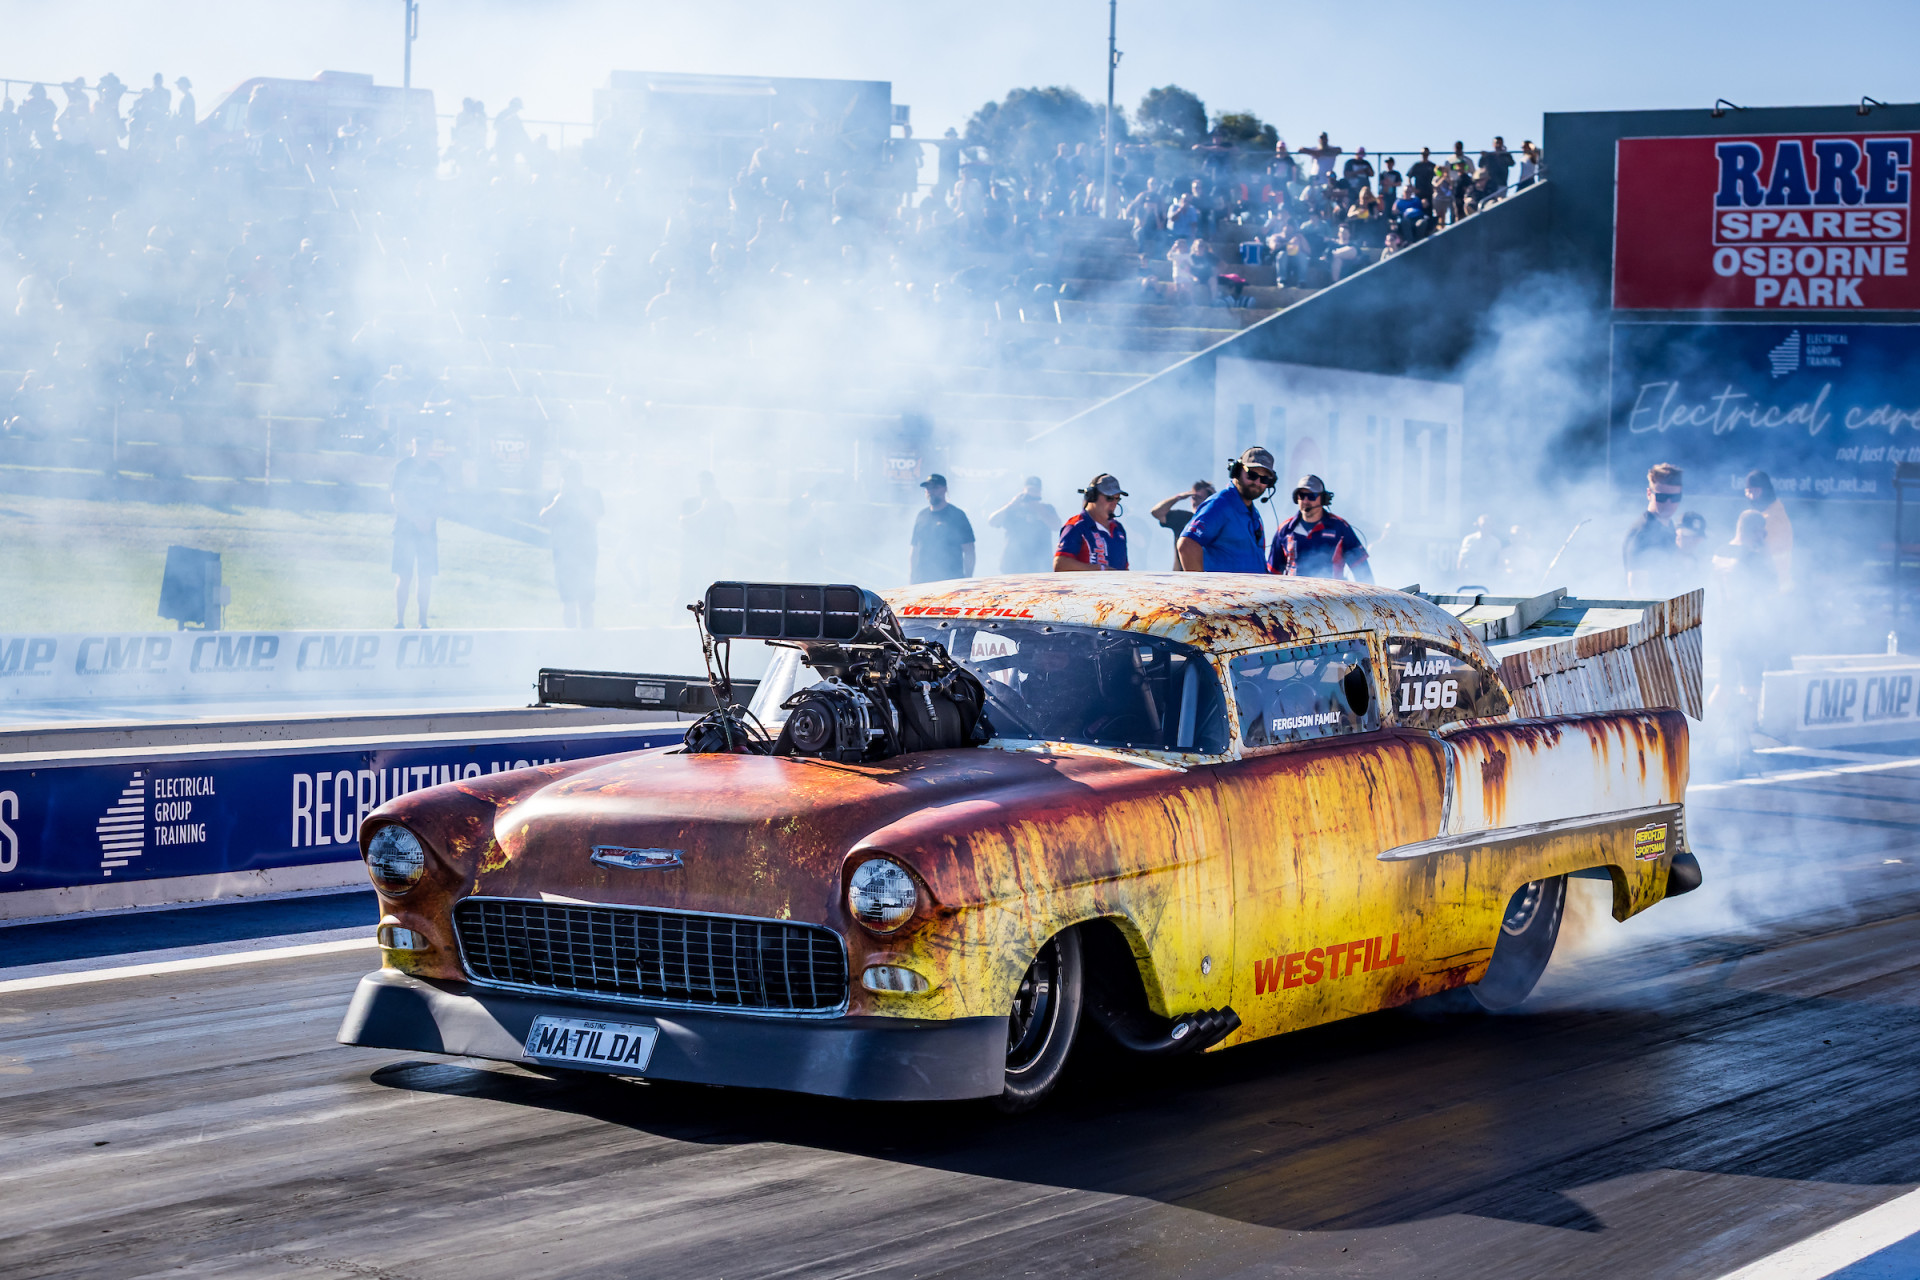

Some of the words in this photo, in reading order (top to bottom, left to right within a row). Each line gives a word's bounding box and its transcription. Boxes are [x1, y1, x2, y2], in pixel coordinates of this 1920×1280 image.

[1714, 138, 1912, 207] RARE
[1720, 211, 1903, 240] SPARES
[1713, 247, 1908, 277] OSBORNE
[1755, 278, 1864, 306] PARK
[1806, 334, 1848, 345] ELECTRICAL
[1806, 356, 1841, 367] TRAINING
[1629, 381, 1831, 436] Electrical
[1908, 446, 1920, 462] th
[903, 606, 1034, 619] WESTFILL
[76, 636, 172, 676] CMP
[190, 636, 279, 673] CMP
[296, 635, 381, 672] CMP
[396, 635, 473, 670] CMP
[1403, 659, 1452, 678] AA/APA
[1399, 680, 1459, 712] 1196
[1804, 678, 1858, 726] CMP
[1863, 675, 1913, 721] CMP
[1272, 714, 1314, 732] FERGUSON
[1314, 711, 1342, 726] FAMILY
[155, 776, 215, 799] ELECTRICAL
[155, 801, 192, 822] GROUP
[155, 823, 206, 846] TRAINING
[1636, 842, 1665, 857] SPORTSMAN
[1254, 932, 1406, 996] WESTFILL
[536, 1026, 642, 1065] MATILDA
